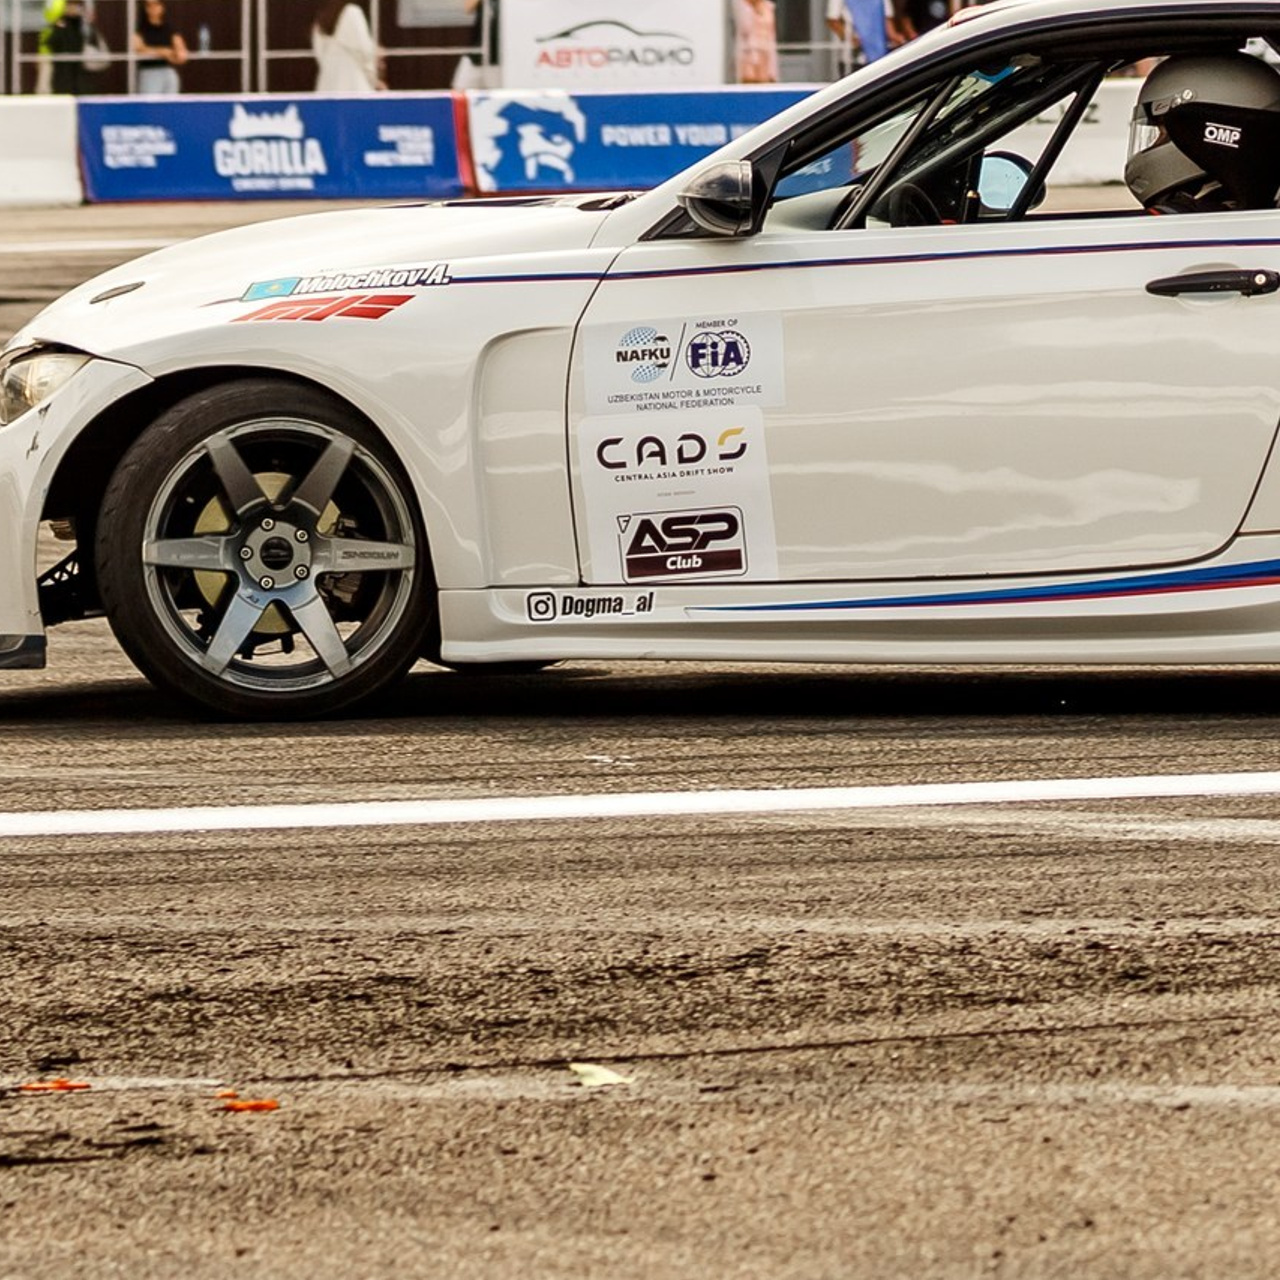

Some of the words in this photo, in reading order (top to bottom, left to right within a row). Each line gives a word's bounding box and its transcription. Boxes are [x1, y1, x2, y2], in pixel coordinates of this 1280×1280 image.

[535, 47, 695, 68] АВТОРАДИО
[602, 124, 672, 147] POWER
[675, 124, 727, 147] YOUR
[1204, 126, 1241, 144] OMP
[213, 137, 328, 177] GORILLA
[695, 320, 725, 329] MEMBER
[727, 319, 738, 327] OF
[616, 347, 671, 363] NAFKU
[607, 392, 660, 404] UZBEKISTAN
[662, 389, 693, 400] MOTOR
[702, 384, 762, 397] MOTORCYCLE
[636, 400, 678, 412] NATIONAL
[680, 397, 735, 409] FEDERATION
[596, 427, 748, 470] CADS
[614, 473, 655, 483] CENTRAL
[656, 470, 678, 480] ASIA
[679, 469, 706, 479] DRIFT
[707, 467, 735, 476] SHOW
[626, 512, 739, 556] ASP
[665, 554, 703, 571] Club
[561, 591, 655, 618] Dogma_al
